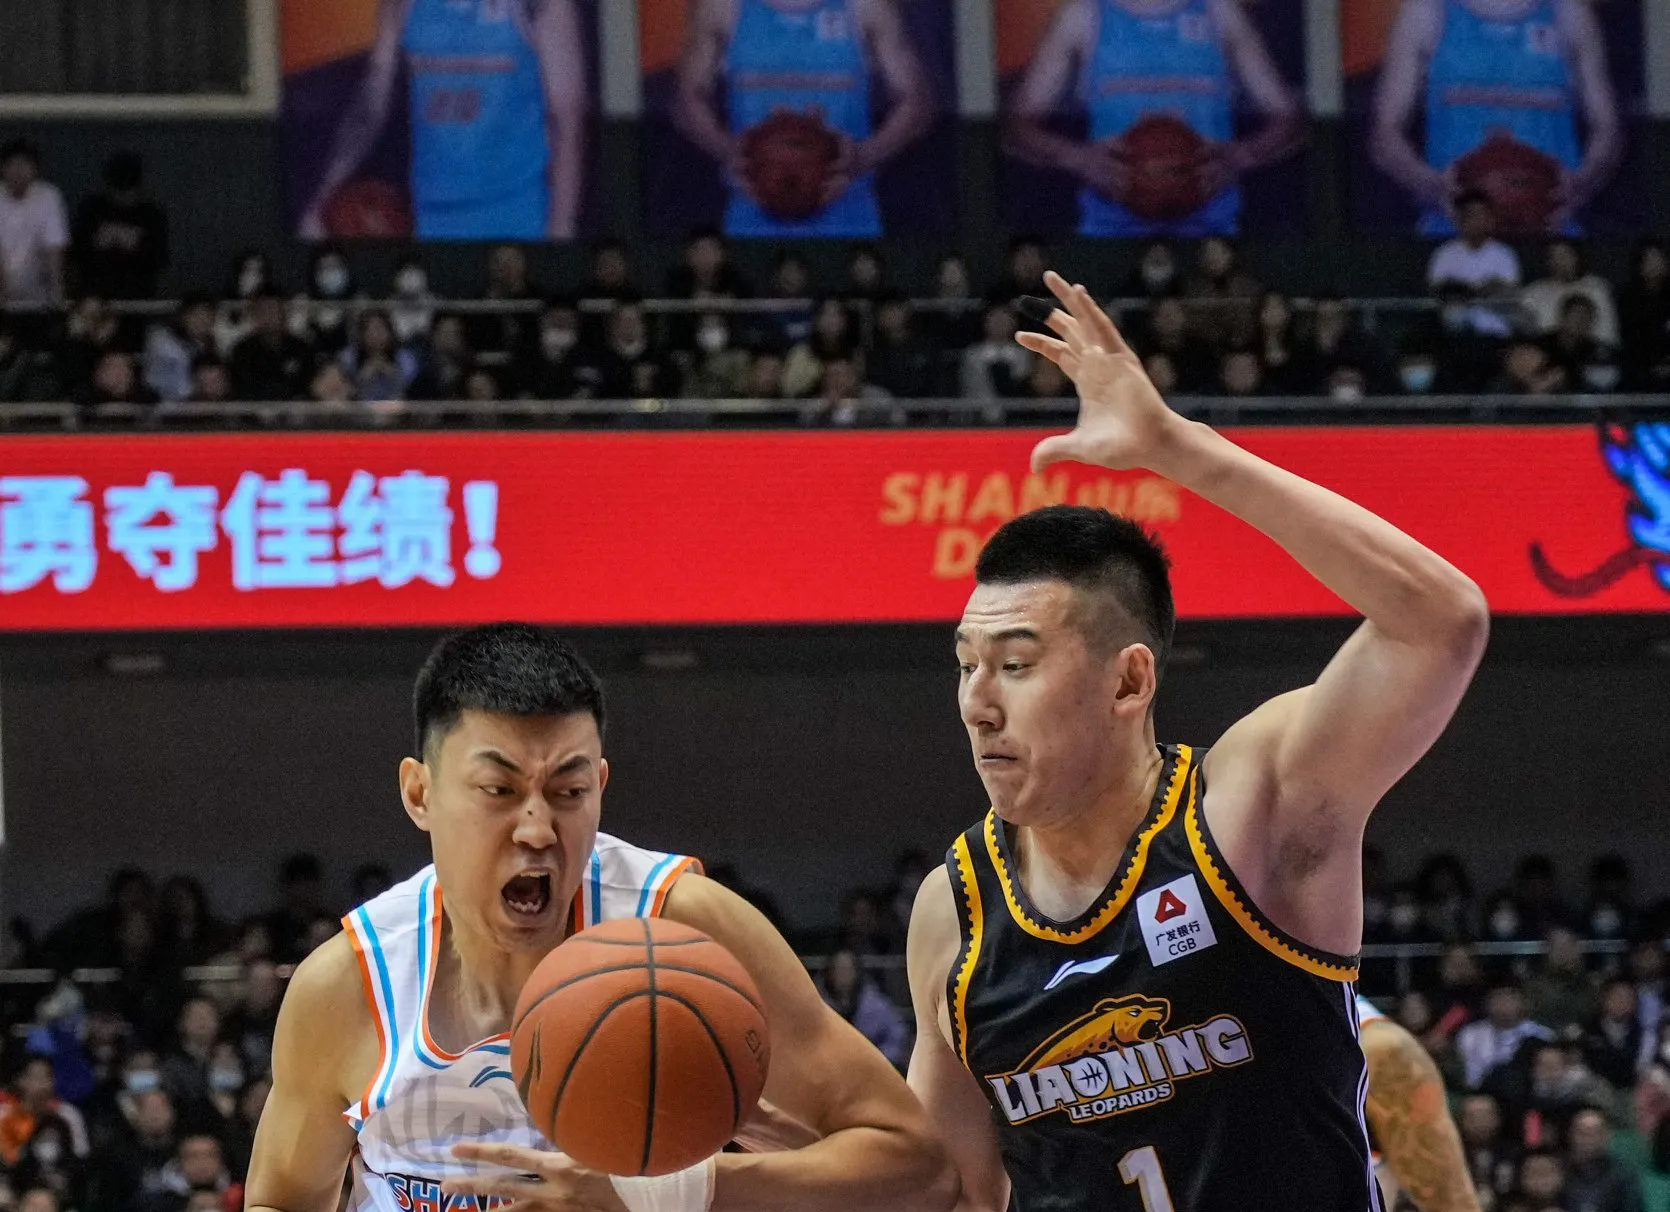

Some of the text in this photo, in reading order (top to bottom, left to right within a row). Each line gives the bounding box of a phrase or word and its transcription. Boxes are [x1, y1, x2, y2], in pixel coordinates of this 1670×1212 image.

[0, 469, 502, 594] 勇夺佳绩!
[1155, 920, 1201, 946] 广发银行
[1168, 937, 1197, 956] CGB
[988, 1017, 1251, 1123] LIAONING
[1069, 1082, 1173, 1121] LEOPARDS
